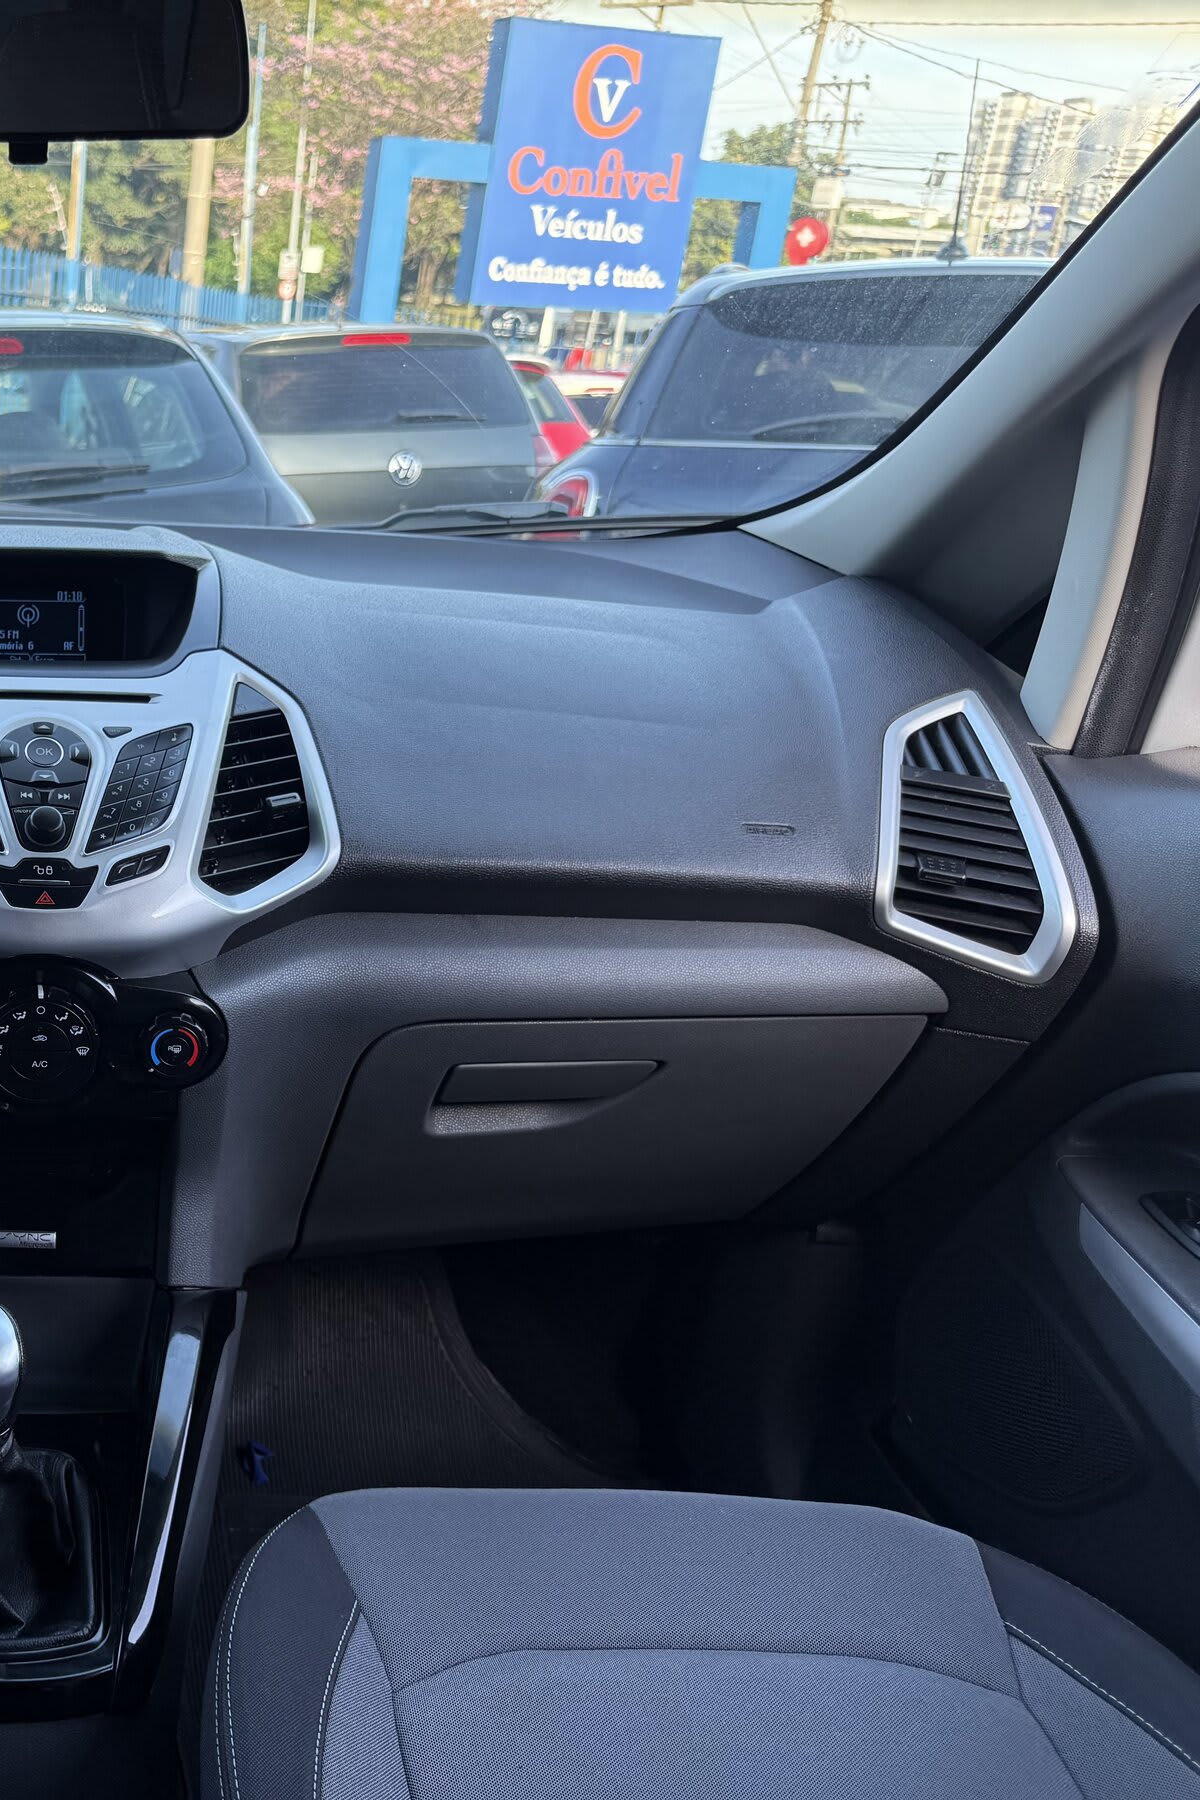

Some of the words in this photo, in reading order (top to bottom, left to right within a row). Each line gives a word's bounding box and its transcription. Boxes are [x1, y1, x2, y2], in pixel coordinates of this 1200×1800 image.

[530, 204, 644, 244] Veículos
[488, 256, 591, 291] Confiança
[594, 261, 609, 287] é
[612, 263, 665, 289] tudo.
[57, 591, 83, 602] 01:18
[7, 630, 19, 639] FM
[28, 641, 34, 650] 6
[63, 641, 75, 650] AF
[35, 747, 54, 756] OK
[129, 823, 136, 831] 0
[31, 1060, 48, 1068] A/C
